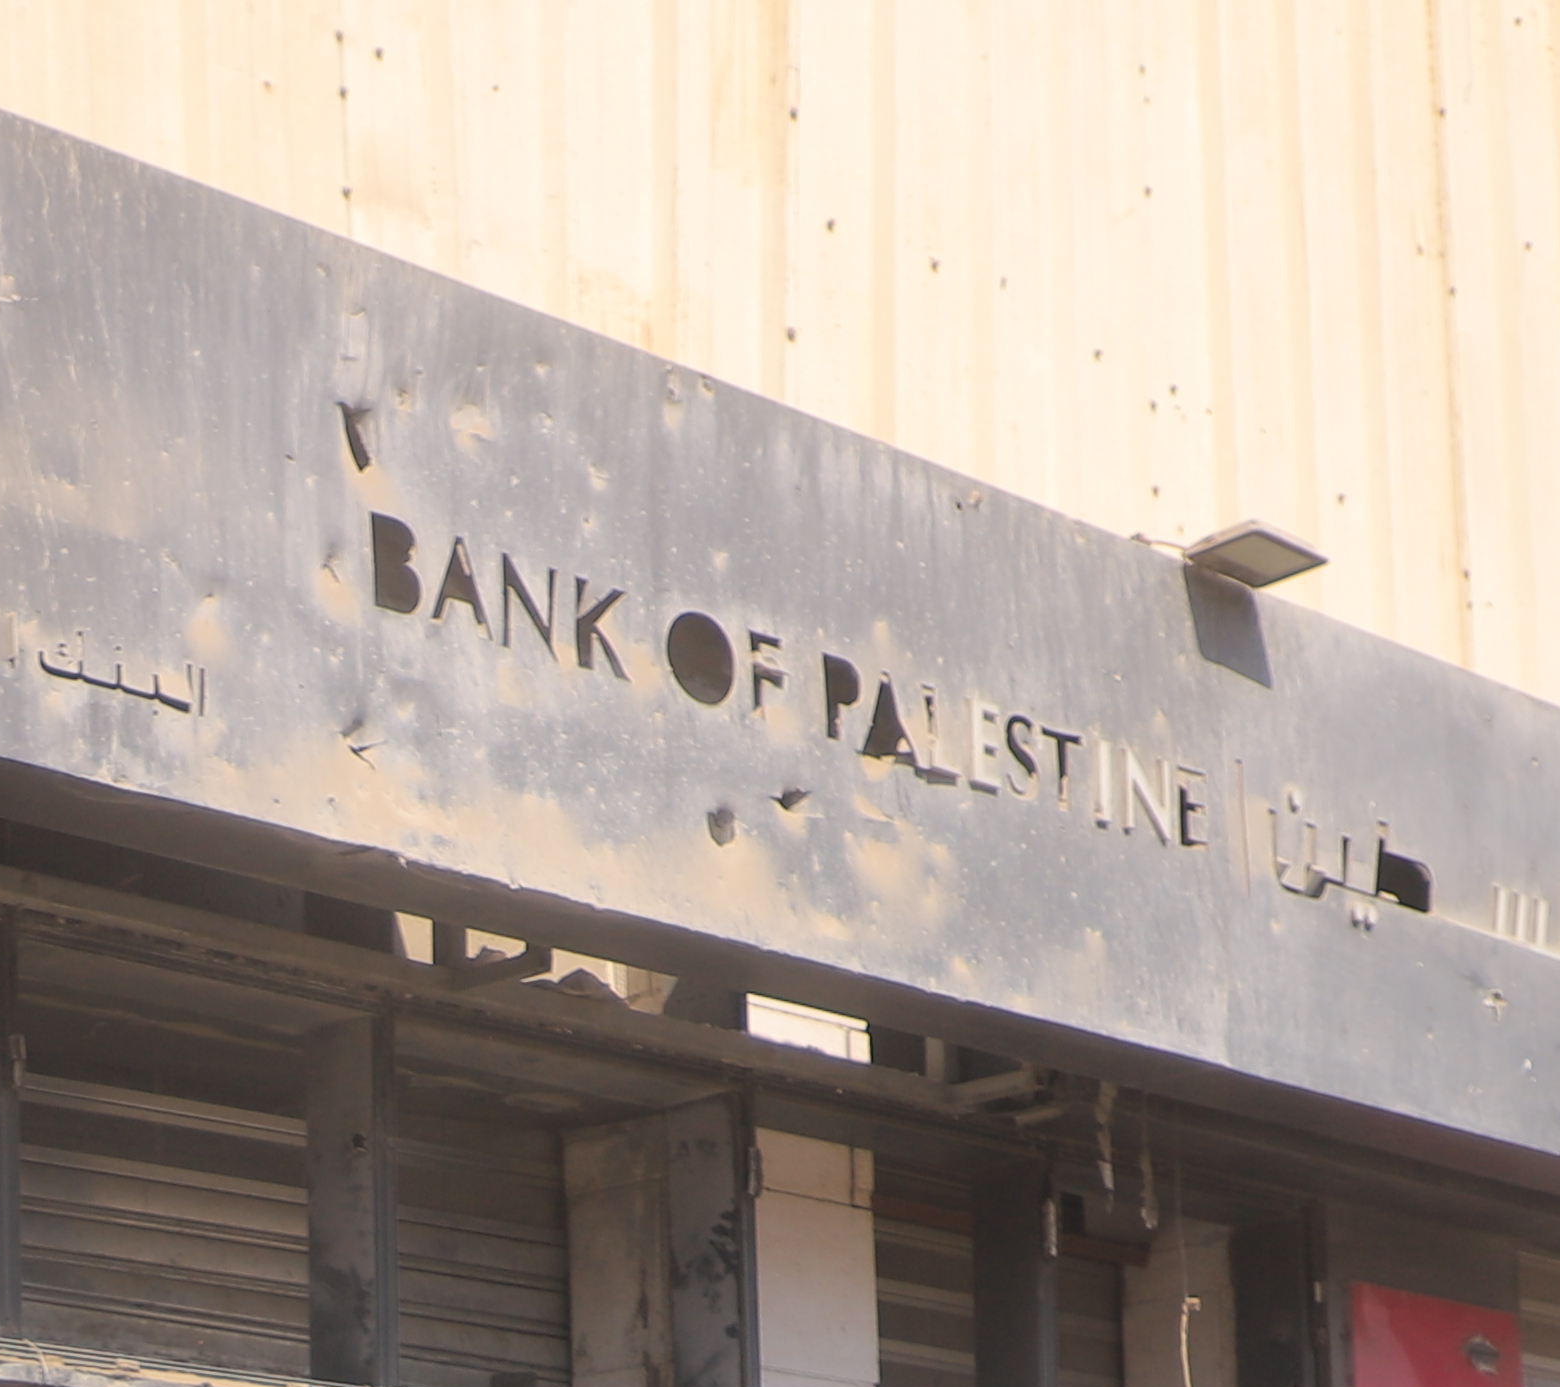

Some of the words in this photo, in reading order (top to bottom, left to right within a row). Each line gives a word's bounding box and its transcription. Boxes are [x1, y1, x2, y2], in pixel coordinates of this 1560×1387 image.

[368, 509, 634, 683] BANK
[666, 610, 791, 720] OF
[820, 652, 1210, 850] PALESTINE
